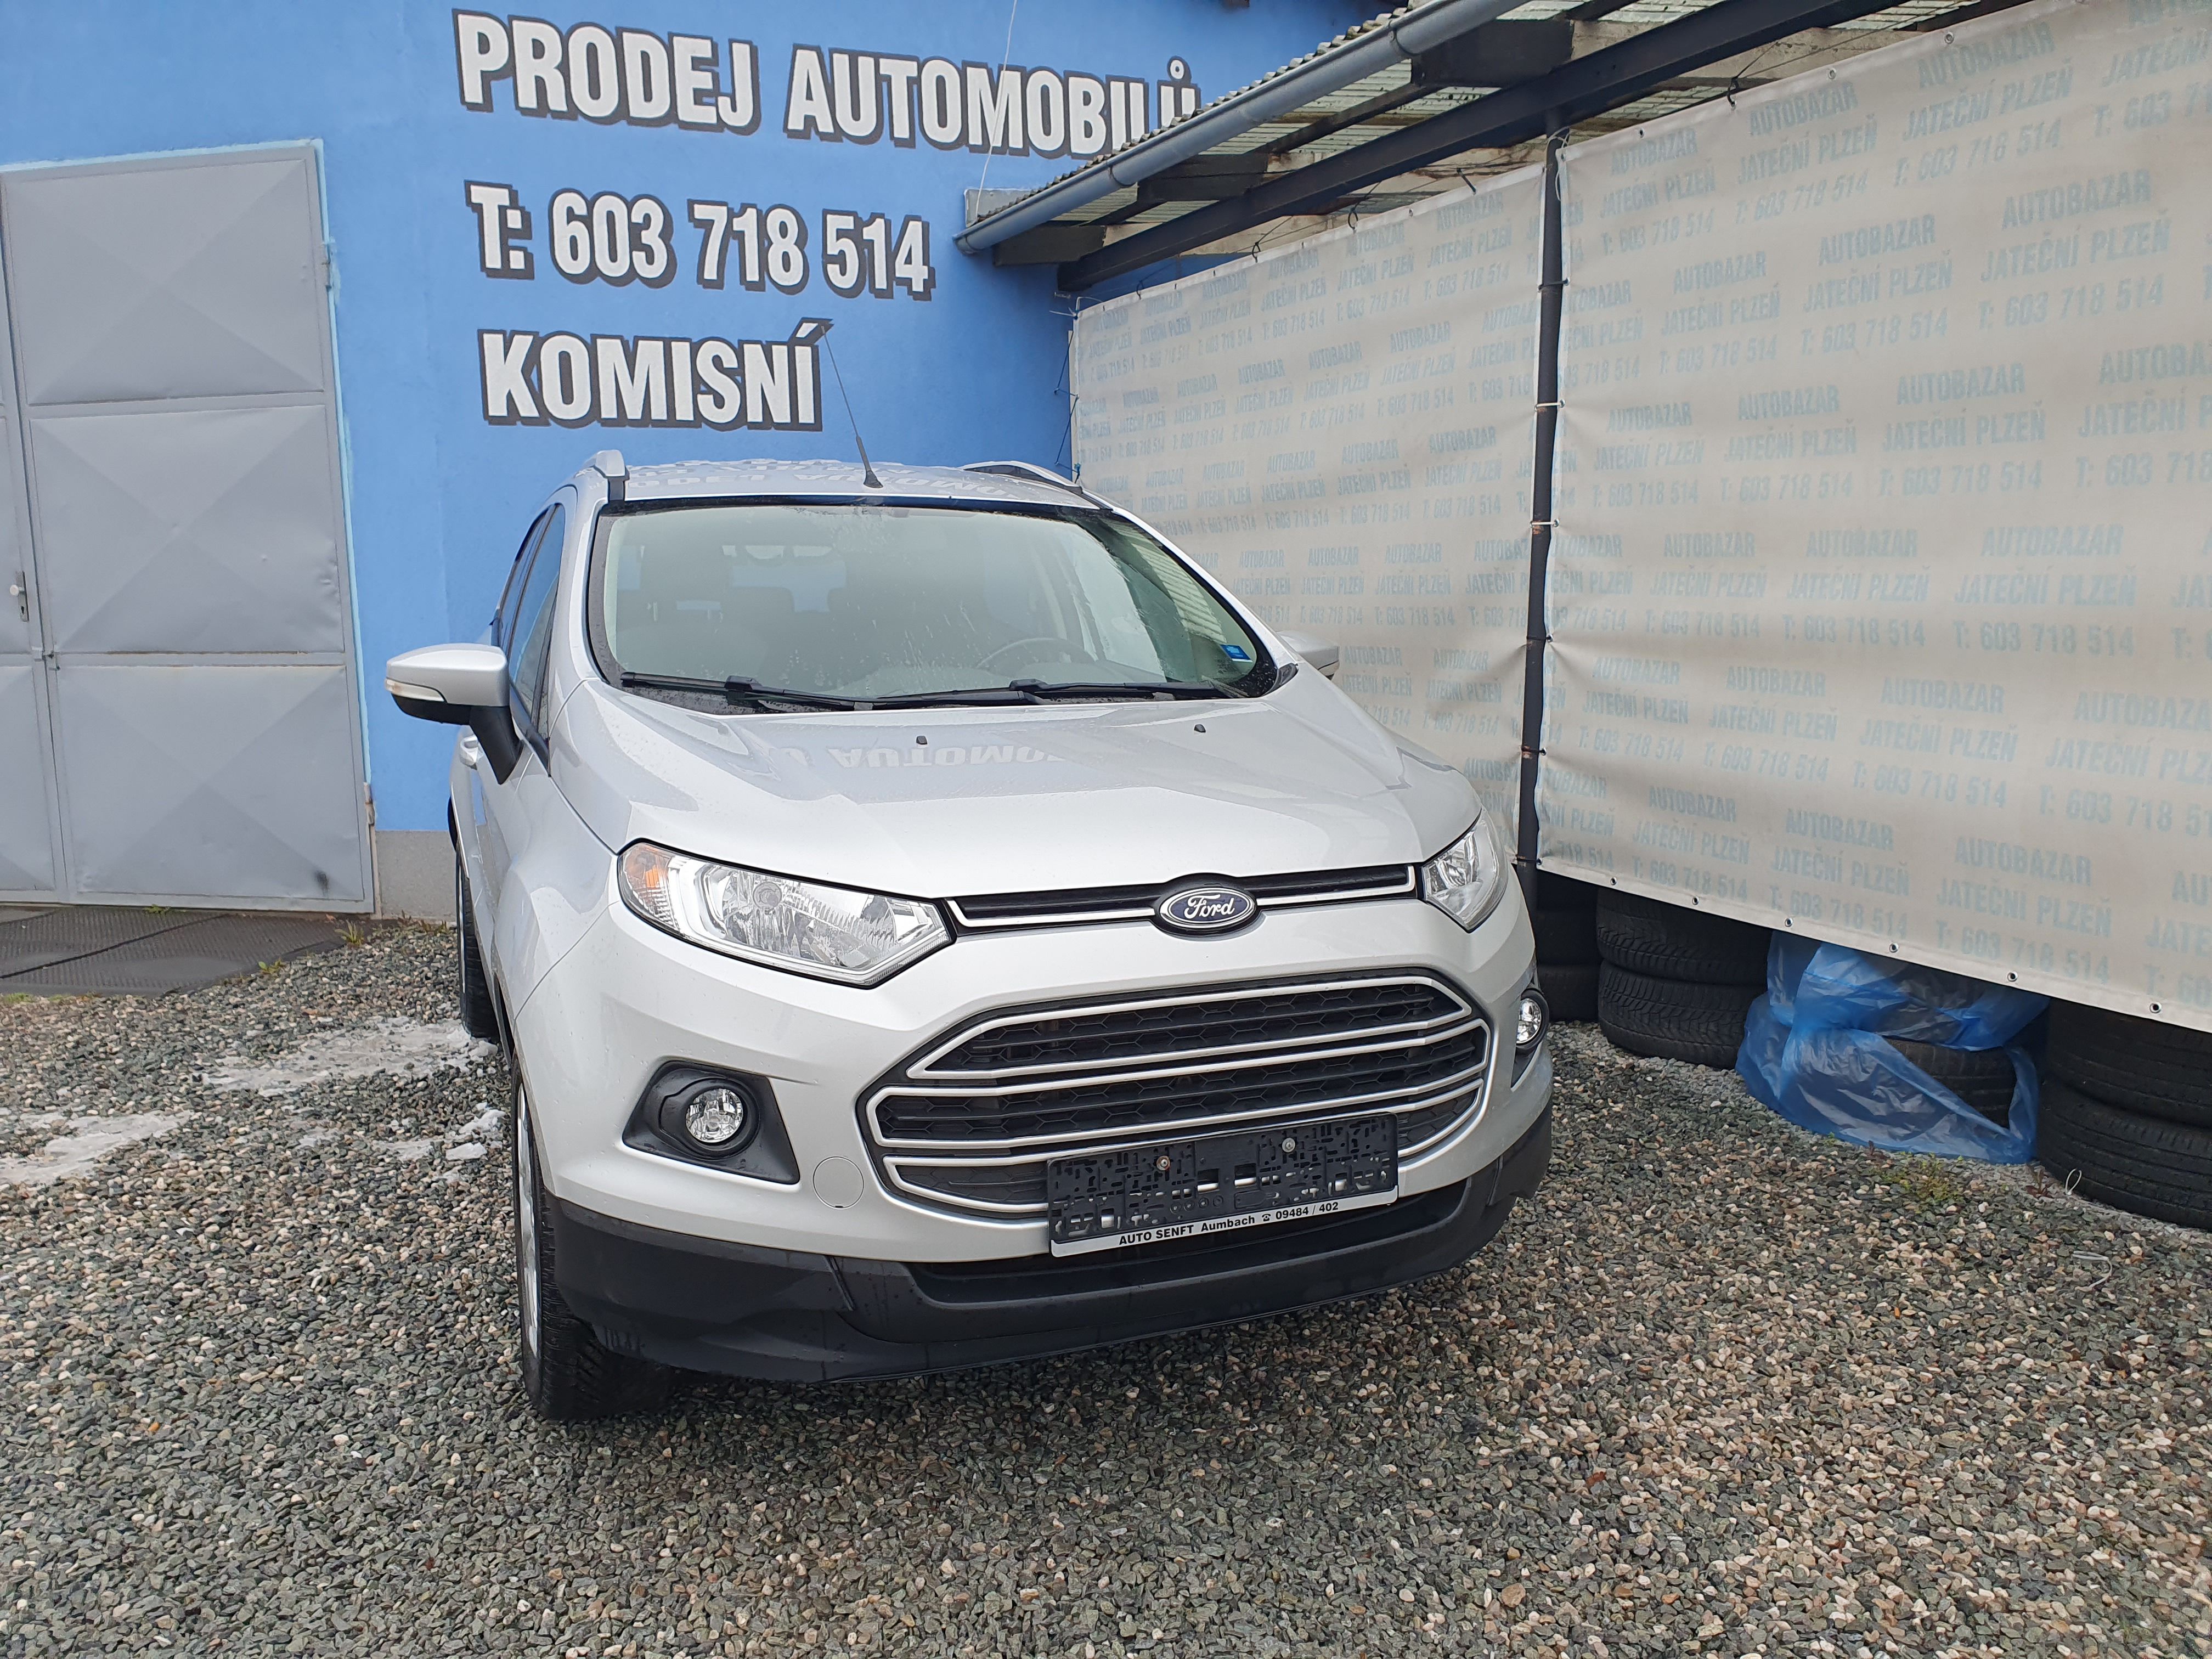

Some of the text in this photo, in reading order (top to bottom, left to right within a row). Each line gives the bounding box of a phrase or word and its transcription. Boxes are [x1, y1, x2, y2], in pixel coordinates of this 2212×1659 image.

[455, 11, 757, 133] PRODEJ
[2001, 168, 2151, 230] AUTOBAZAR
[467, 183, 934, 299] T: 603 718 514
[1818, 213, 1936, 266] AUTOBAZAR
[1673, 251, 1767, 294] AUTOBAZAR
[2005, 291, 2048, 328] 603
[2061, 282, 2104, 320] 718
[2117, 273, 2165, 312] 514
[1822, 321, 1856, 354] 603
[1866, 315, 1901, 347] 718
[1909, 307, 1947, 341] 514
[481, 319, 830, 430] KOMISNÍ
[1676, 347, 1703, 374] 603
[1711, 340, 1739, 368] 718
[1747, 334, 1777, 363] 514
[1737, 384, 1839, 421] AUTOBAZAR
[1896, 362, 2025, 405] AUTOBAZAR
[1740, 477, 1770, 503] 603
[1778, 473, 1809, 500] 718
[1819, 471, 1853, 499] 514
[1879, 459, 2042, 496] T: 603 718 514
[1805, 530, 1918, 557] AUTOBAZAR
[1980, 524, 2124, 557] AUTOBAZAR
[1803, 616, 1836, 642] 603
[1844, 616, 1880, 645] 718
[1888, 619, 1926, 647] 514
[1952, 620, 2135, 658] T: 603 718 514
[1726, 666, 1826, 697] AUTOBAZAR
[1880, 676, 2005, 714] AUTOBAZAR
[1720, 746, 1752, 771] 603
[1758, 750, 1791, 779] 718
[1795, 754, 1830, 782] 514
[1852, 759, 2007, 809] T: 603 718 514
[1649, 785, 1737, 822] AUTOBAZAR
[1786, 808, 1894, 852] AUTOBAZAR
[1649, 859, 1676, 885] 603
[1683, 866, 1712, 893] 718
[1718, 874, 1748, 902] 514
[1955, 837, 2091, 888] AUTOBAZAR
[1184, 894, 1235, 919] Ford
[1790, 890, 1822, 919] 603
[1830, 898, 1864, 930] 718
[1871, 909, 1908, 939] 514
[1961, 927, 2002, 960] 603
[2011, 936, 2054, 971] 718
[2064, 949, 2110, 984] 514
[1119, 1232, 1152, 1245] AUTO
[1156, 1224, 1194, 1240] SENFT
[1201, 1215, 1255, 1233] Aumbach
[1275, 1206, 1309, 1221] 09484
[1319, 1201, 1339, 1214] 402
